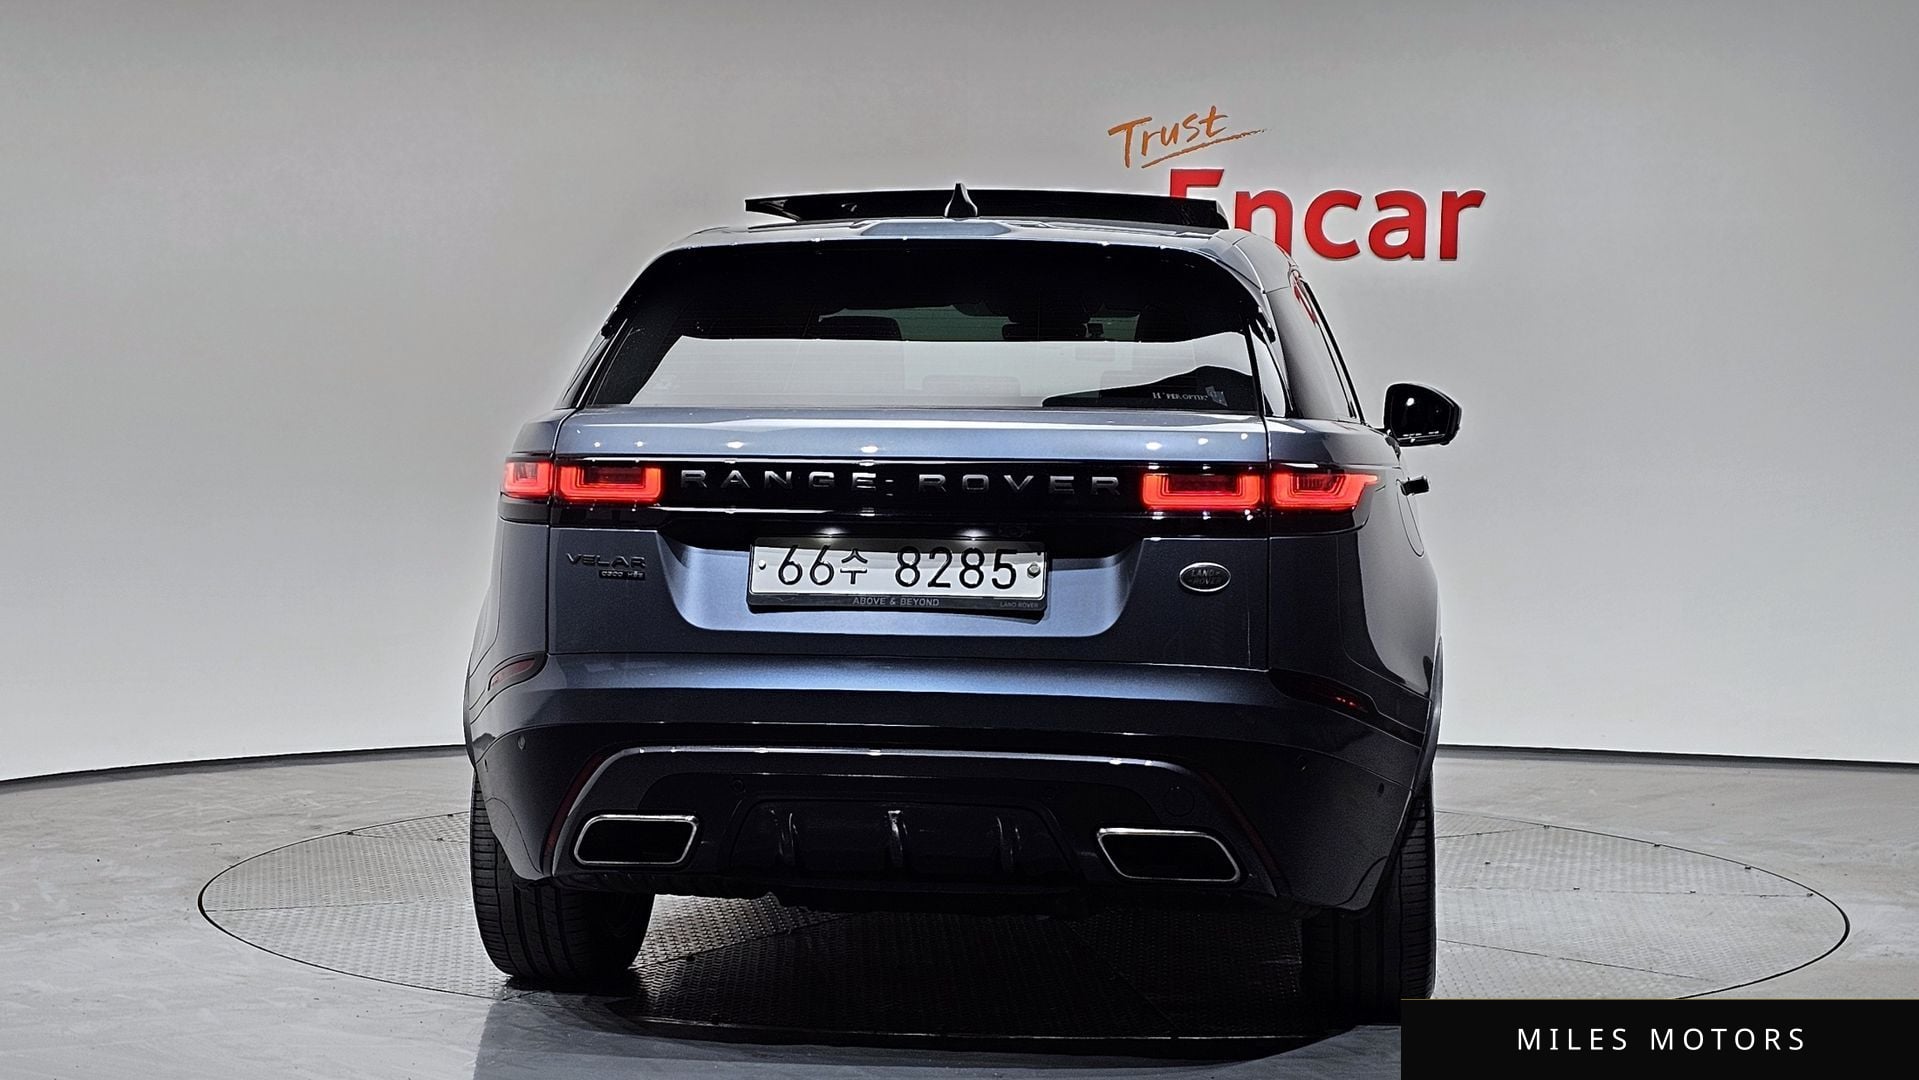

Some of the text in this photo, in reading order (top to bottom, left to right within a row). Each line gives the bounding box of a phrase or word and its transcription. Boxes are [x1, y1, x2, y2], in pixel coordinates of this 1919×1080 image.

[1107, 105, 1229, 168] Trust
[680, 469, 1121, 496] RANGE ROVER
[566, 553, 646, 568] VELAR
[778, 544, 1018, 590] 66수 8285
[852, 597, 940, 607] ABOVE & BEYOND
